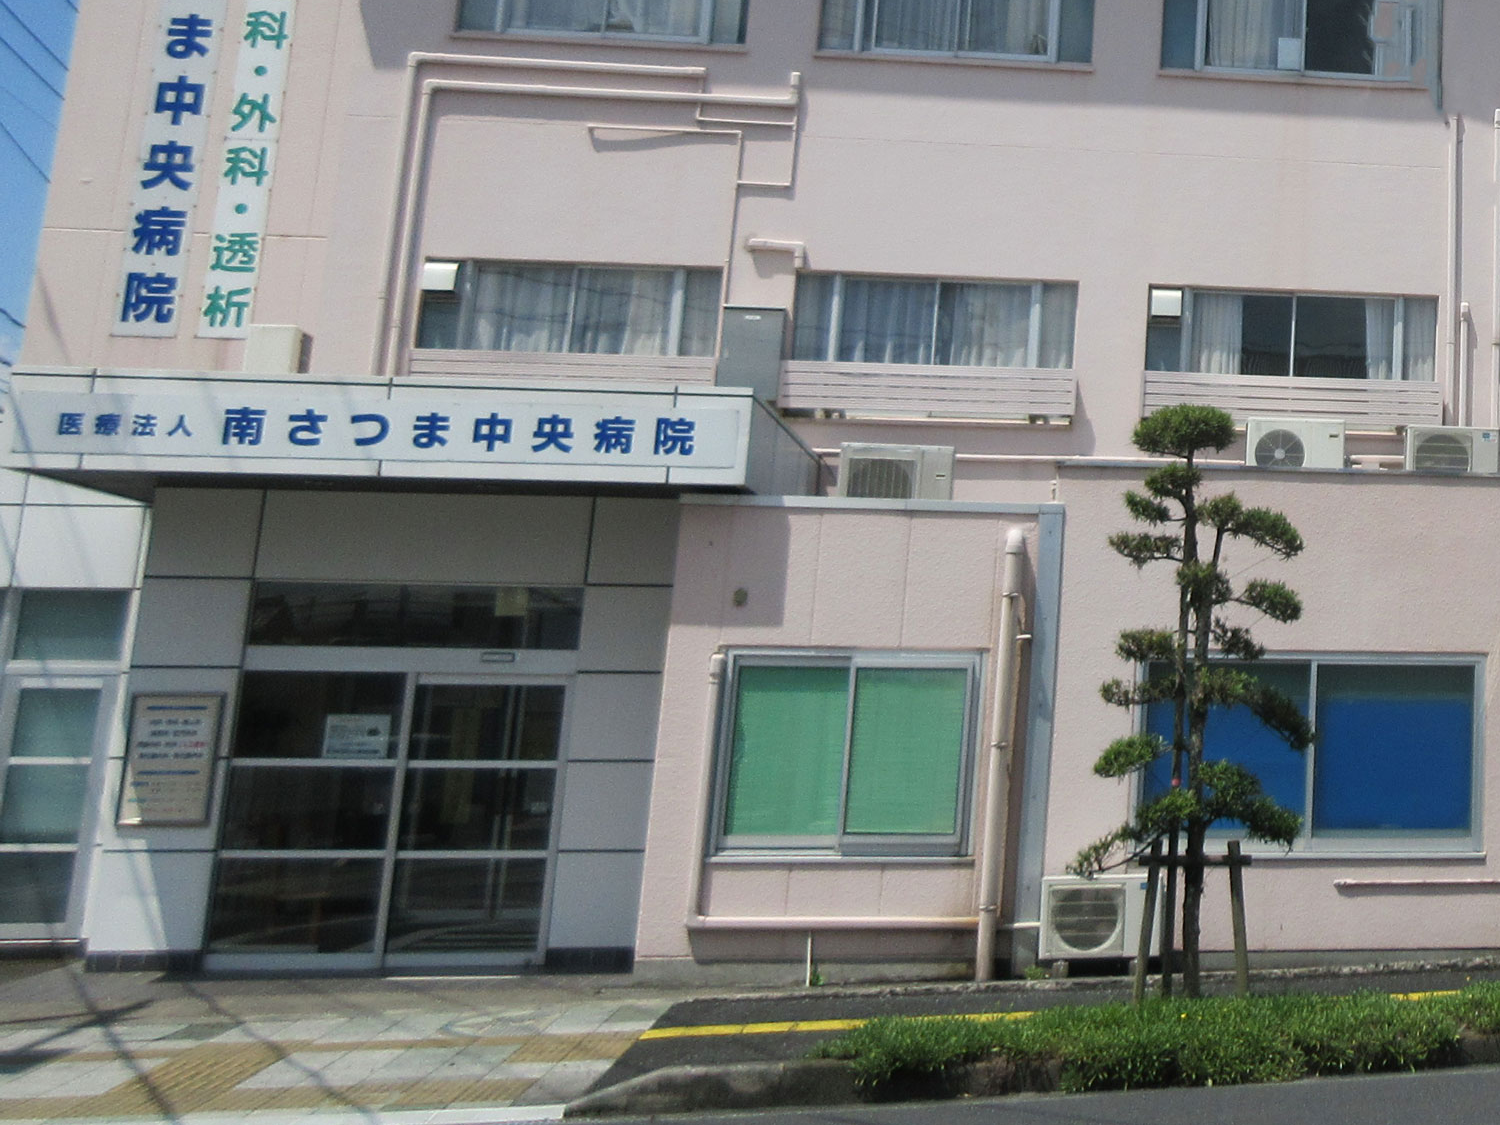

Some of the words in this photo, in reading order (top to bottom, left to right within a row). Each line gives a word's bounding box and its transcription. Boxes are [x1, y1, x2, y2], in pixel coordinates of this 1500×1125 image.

[58, 411, 193, 438] 医療法人
[221, 405, 696, 457] 南さつま中央病院
